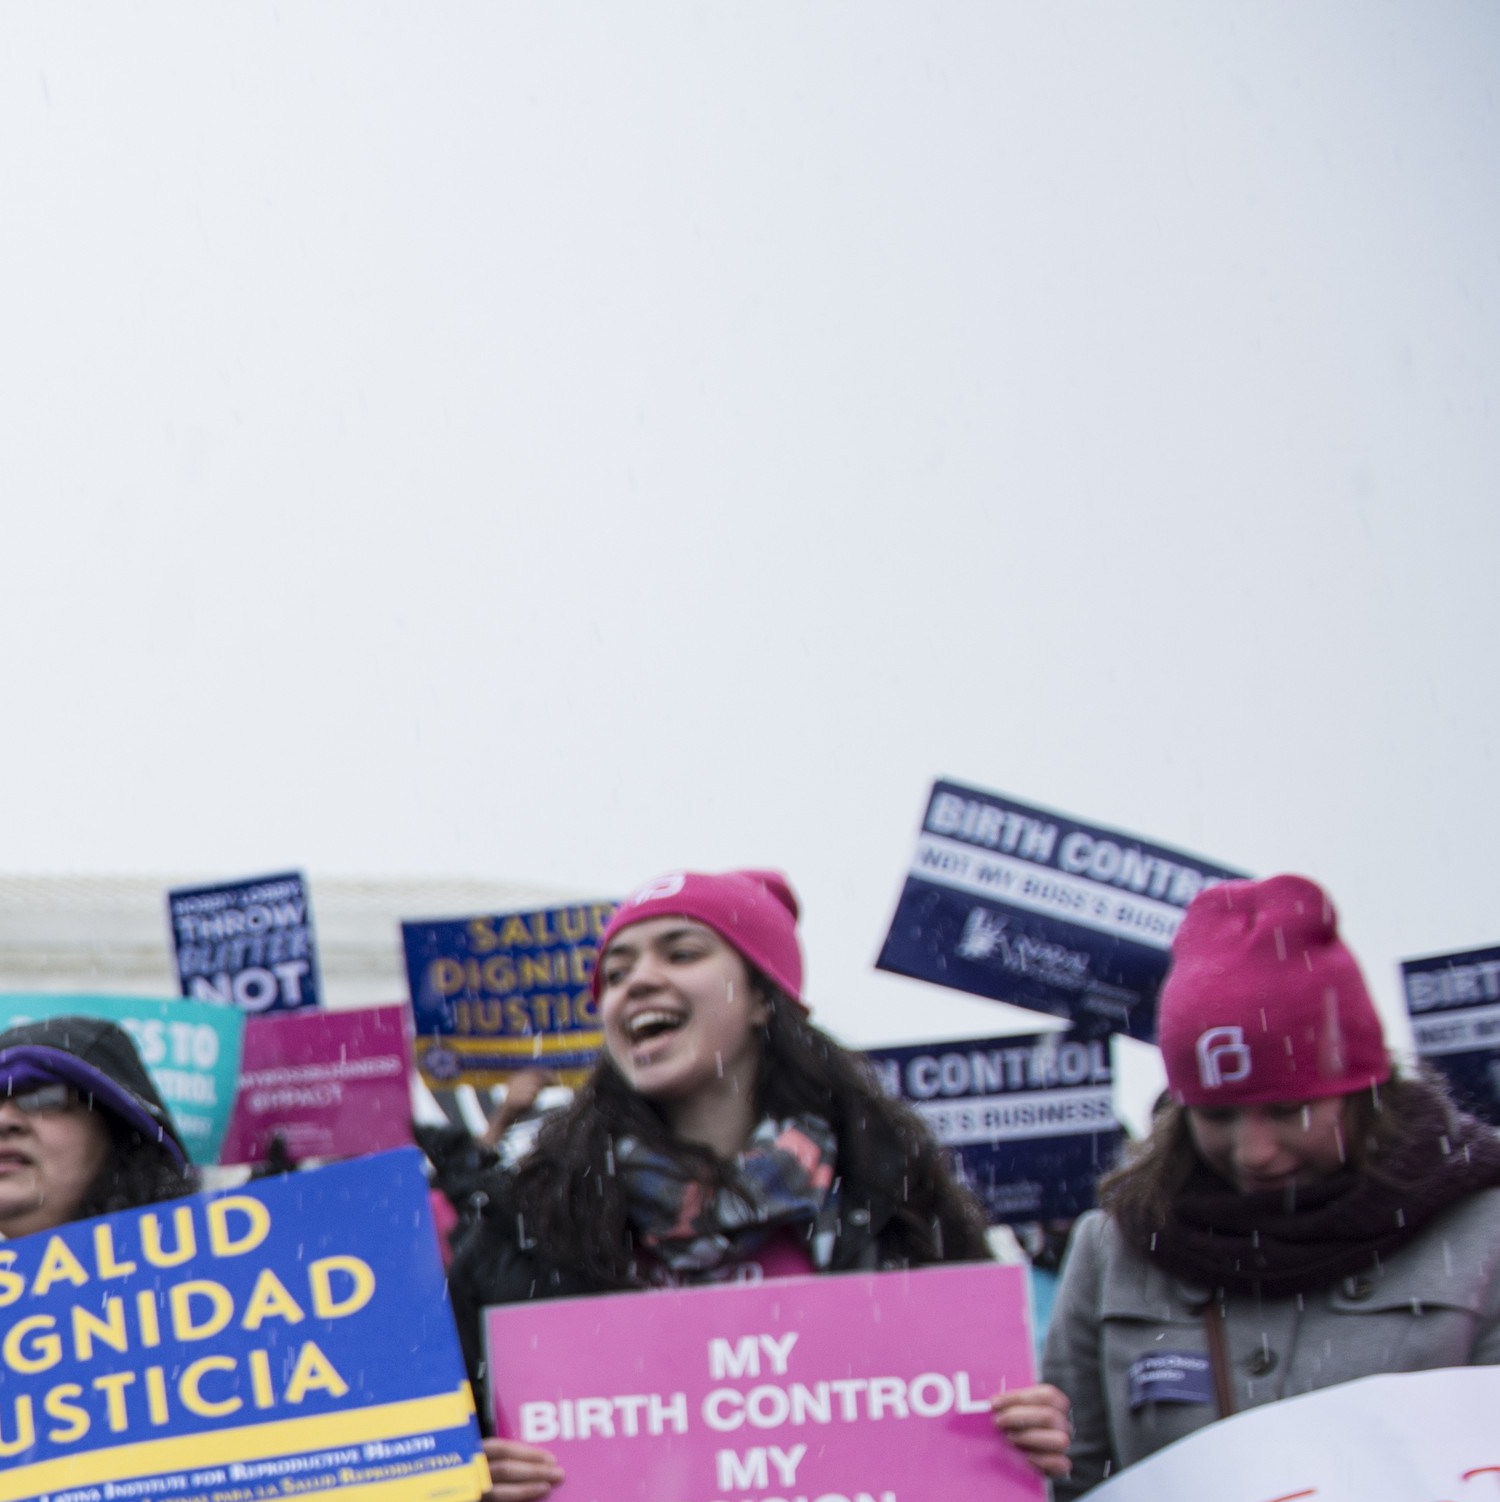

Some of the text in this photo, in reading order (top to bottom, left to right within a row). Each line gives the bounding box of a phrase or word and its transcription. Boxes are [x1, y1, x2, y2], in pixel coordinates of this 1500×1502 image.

[926, 791, 1212, 908] BIRTH CONTR
[178, 902, 304, 945] THROW
[189, 962, 311, 1013] NOT
[168, 1021, 219, 1070] TO
[905, 1041, 1111, 1099] CONTROL
[708, 1332, 799, 1381] MY
[520, 1371, 995, 1444] BIRTH CONTROL
[104, 1475, 188, 1500] INSTITUTE
[191, 1467, 227, 1487] FOR
[229, 1449, 361, 1481] REPRODUCTIVE
[363, 1436, 436, 1461] HEALTH
[280, 1475, 337, 1494] SALUD
[338, 1453, 463, 1483] REPRODUCTIVA
[716, 1444, 808, 1491] MY
